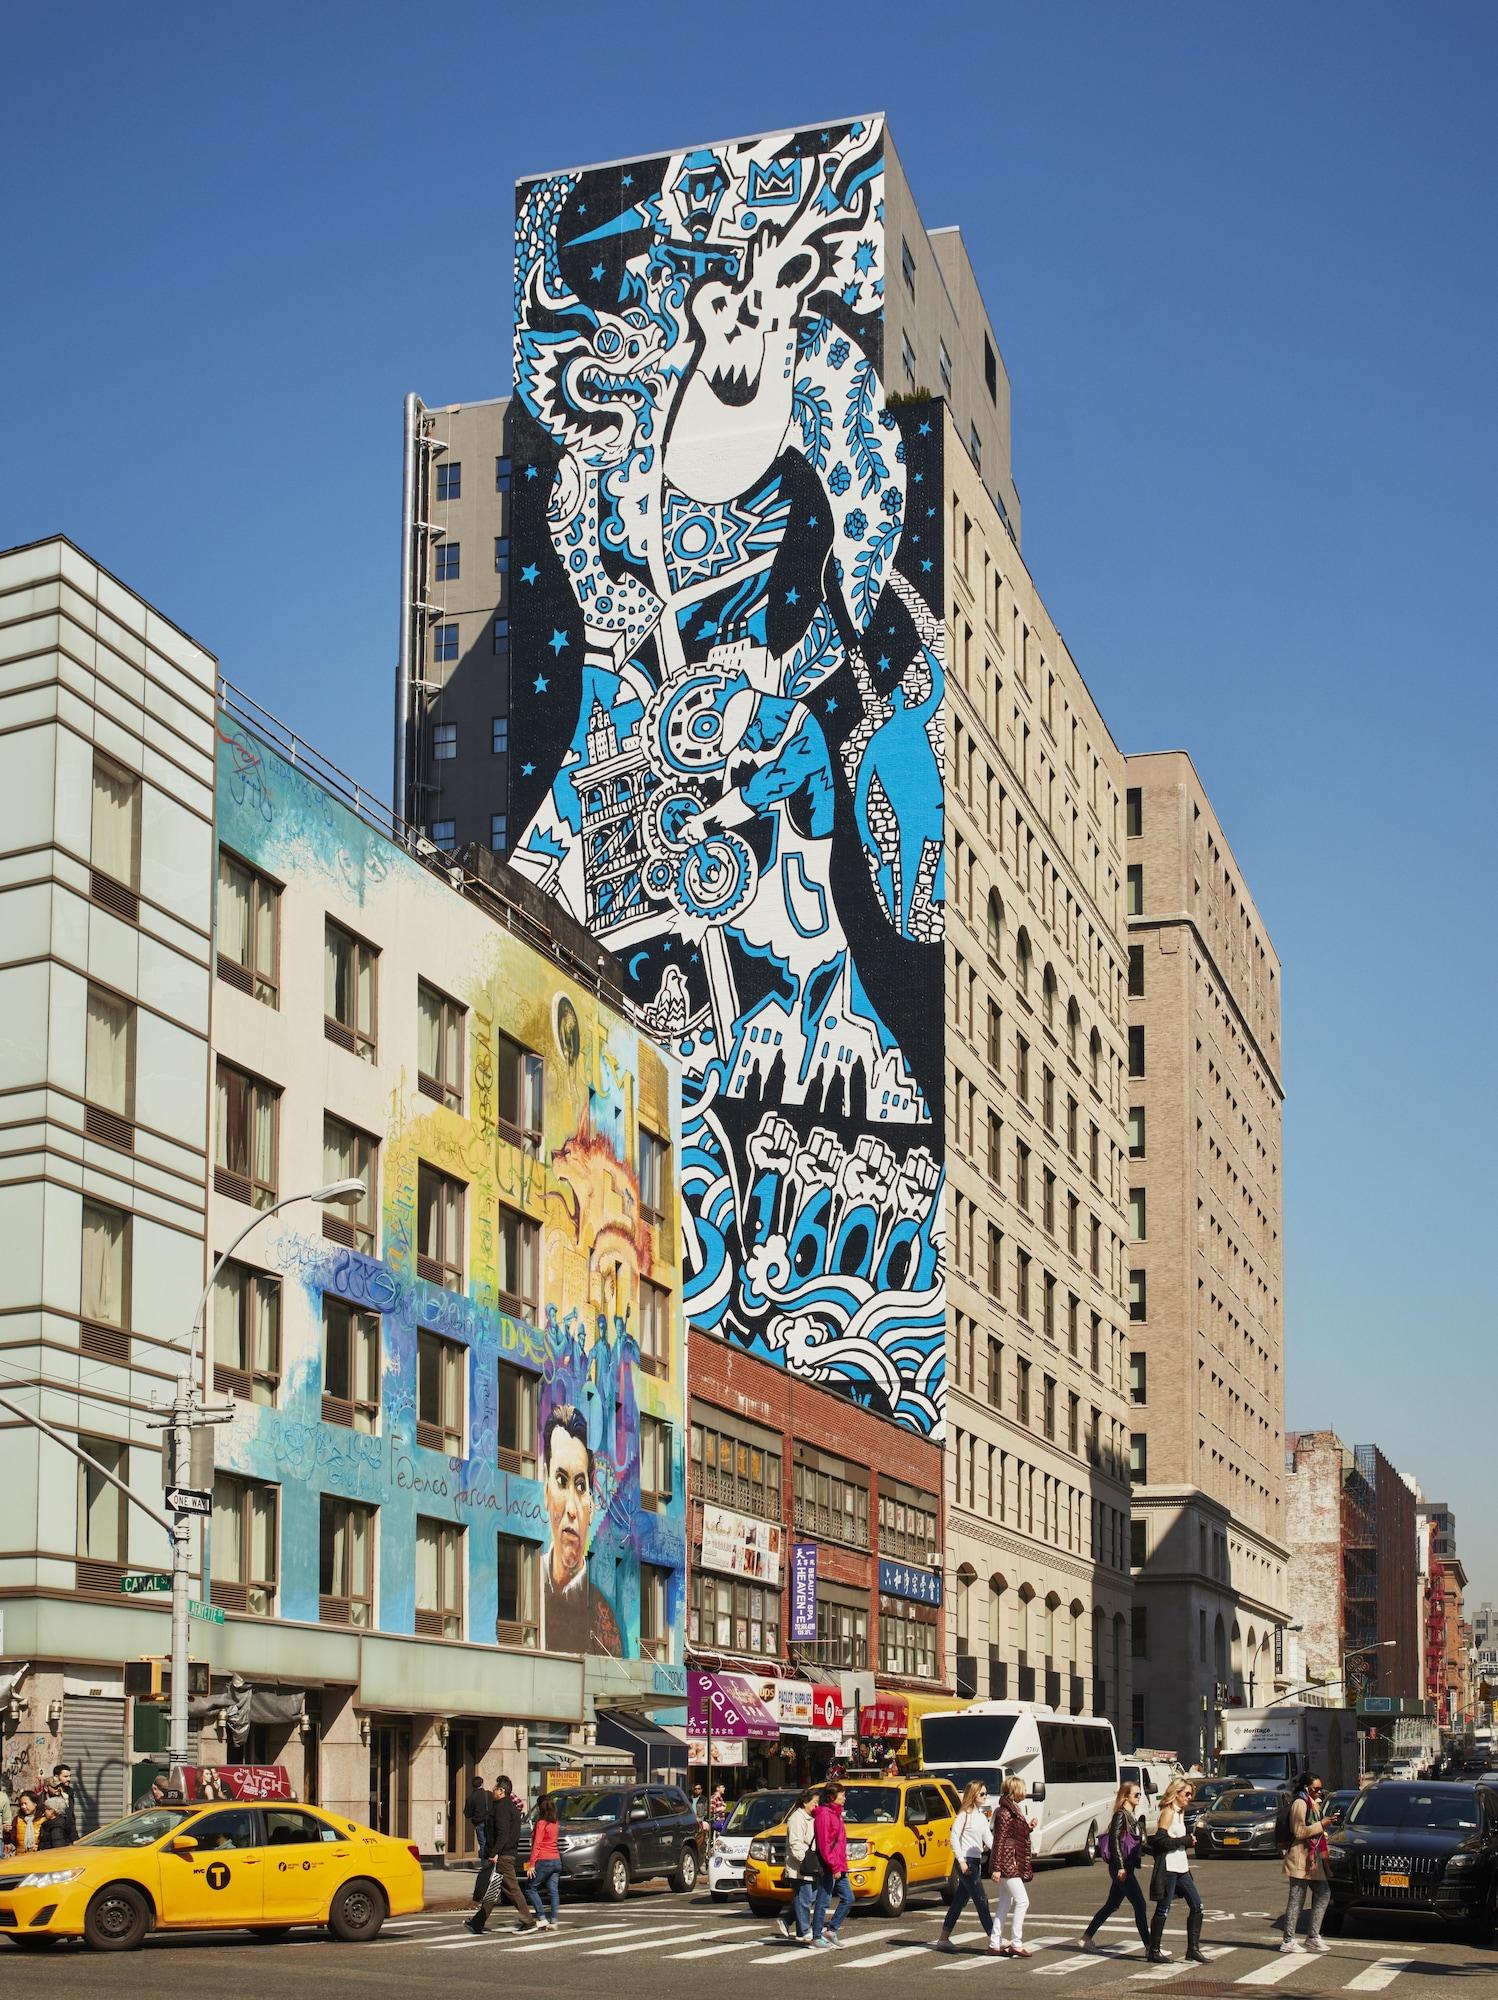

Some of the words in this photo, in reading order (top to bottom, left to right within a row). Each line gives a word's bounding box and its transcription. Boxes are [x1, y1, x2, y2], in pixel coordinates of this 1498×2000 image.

[173, 1495, 189, 1507] ONE
[191, 1498, 208, 1511] WAY
[124, 1576, 161, 1591] CANAL
[807, 1567, 815, 1603] BEAUTY
[796, 1567, 806, 1623] HEAVEN-E
[190, 1601, 217, 1622] LAFAYETTE
[806, 1604, 814, 1621] SPA
[760, 1687, 775, 1699] ups
[233, 1771, 282, 1792] CATCH
[550, 1771, 580, 1779] WINNER!
